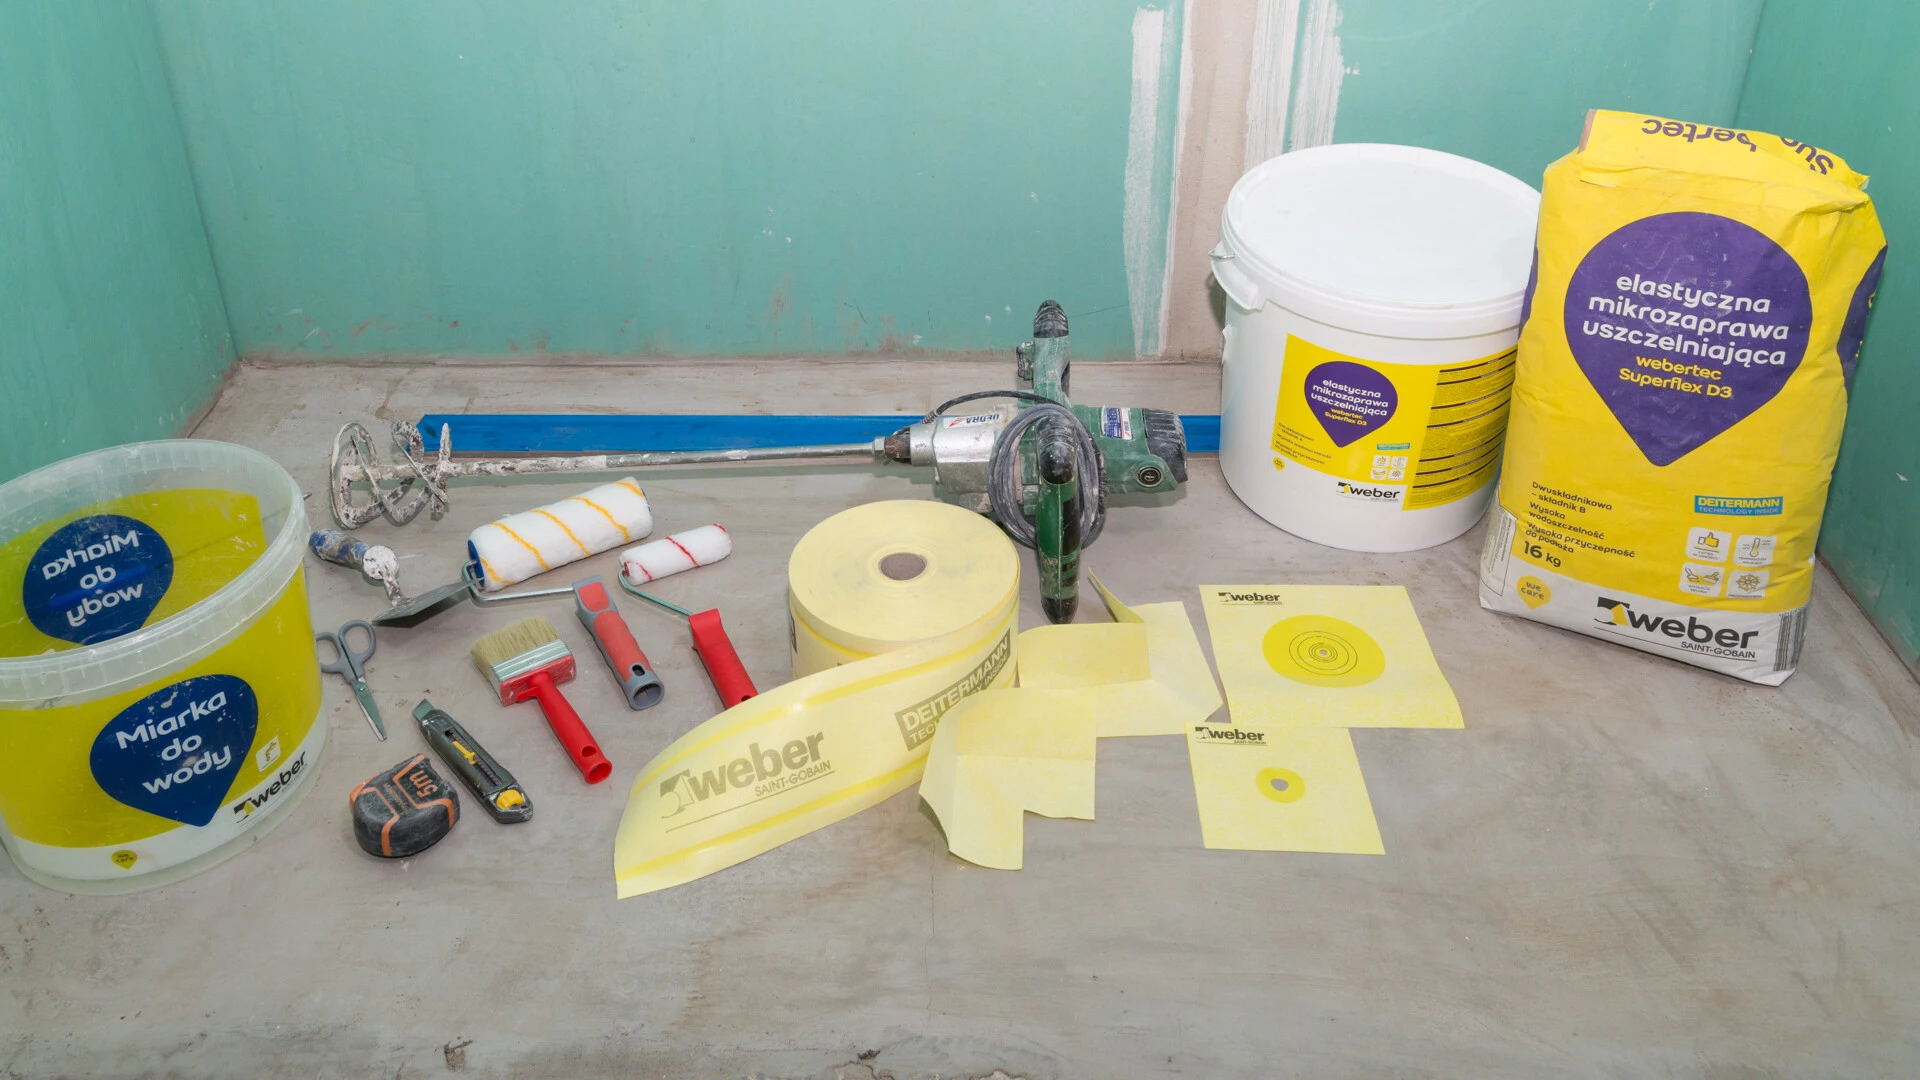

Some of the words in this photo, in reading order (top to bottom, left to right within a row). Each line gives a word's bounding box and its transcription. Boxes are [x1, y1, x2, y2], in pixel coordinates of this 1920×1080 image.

[1616, 274, 1771, 313] elastyczna
[1588, 295, 1789, 340] mikrozaprawa
[1582, 320, 1786, 368] uszczelniająca
[1636, 355, 1722, 381] webertec
[1322, 379, 1381, 398] elastyczna
[1619, 367, 1702, 395] Superflex
[1706, 384, 1733, 398] D3
[1311, 393, 1388, 416] uszczelniająca
[1313, 384, 1389, 408] mikrozaprawa
[1324, 411, 1356, 425] Superflex
[1330, 408, 1363, 420] webertec
[1349, 486, 1401, 499] weber
[1532, 481, 1613, 511] Dwuskładnikowa
[1538, 493, 1577, 512] składnik
[1579, 506, 1586, 514] B
[1697, 497, 1780, 508] DEITERMANN
[1529, 501, 1566, 520] Wysoka
[1698, 506, 1753, 515] TECHNOLOGY
[1525, 529, 1537, 538] do
[1527, 521, 1562, 540] Wysoka
[1528, 511, 1605, 540] wodoszczelność
[1524, 540, 1543, 559] 16
[1545, 552, 1562, 568] kg
[1564, 536, 1636, 558] przyczepność
[1230, 592, 1281, 602] weber
[1520, 587, 1545, 600] care
[1526, 581, 1542, 592] we
[1626, 609, 1759, 649] weber
[1681, 641, 1755, 659] SAINT-GOBAIN
[902, 636, 1008, 732] DEITERMANN
[115, 691, 227, 750] Miarka
[1207, 727, 1265, 741] weber
[161, 734, 202, 762] do
[142, 746, 232, 794] wody
[687, 731, 825, 801] weber
[251, 750, 306, 808] weber
[409, 770, 439, 798] 5m
[754, 759, 832, 798] SAINT-GOBAIN
